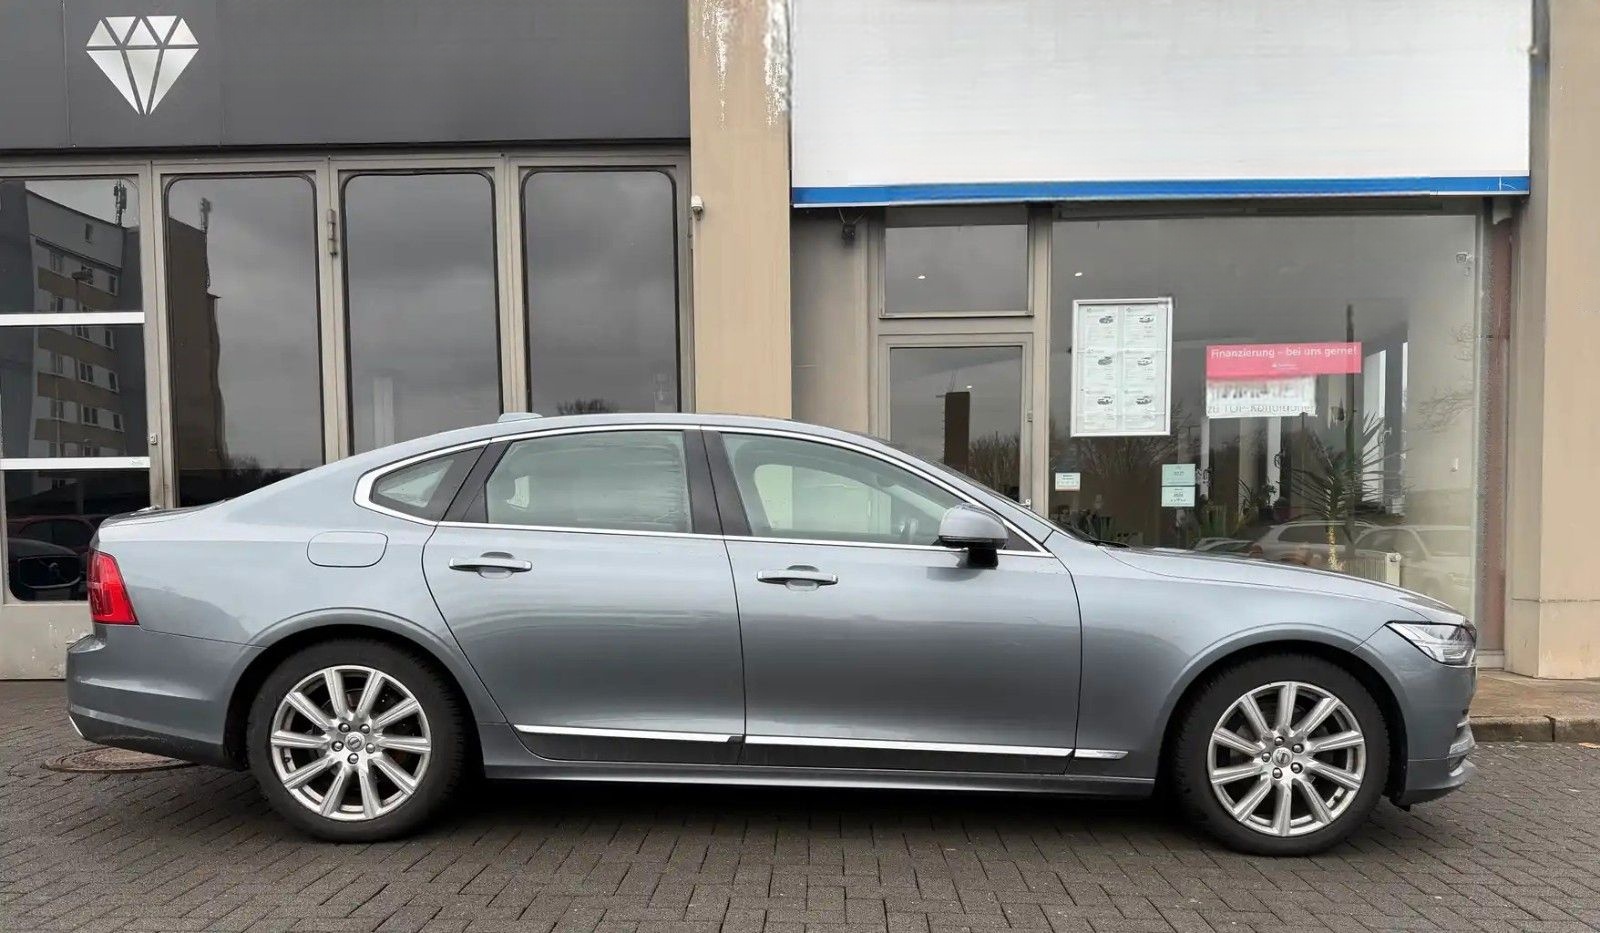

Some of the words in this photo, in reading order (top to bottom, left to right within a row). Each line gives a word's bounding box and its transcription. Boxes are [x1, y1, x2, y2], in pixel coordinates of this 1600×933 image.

[1211, 347, 1275, 359] Finanzierung
[1286, 346, 1300, 356] bei
[1303, 347, 1322, 356] uns
[1324, 345, 1357, 358] gerne!
